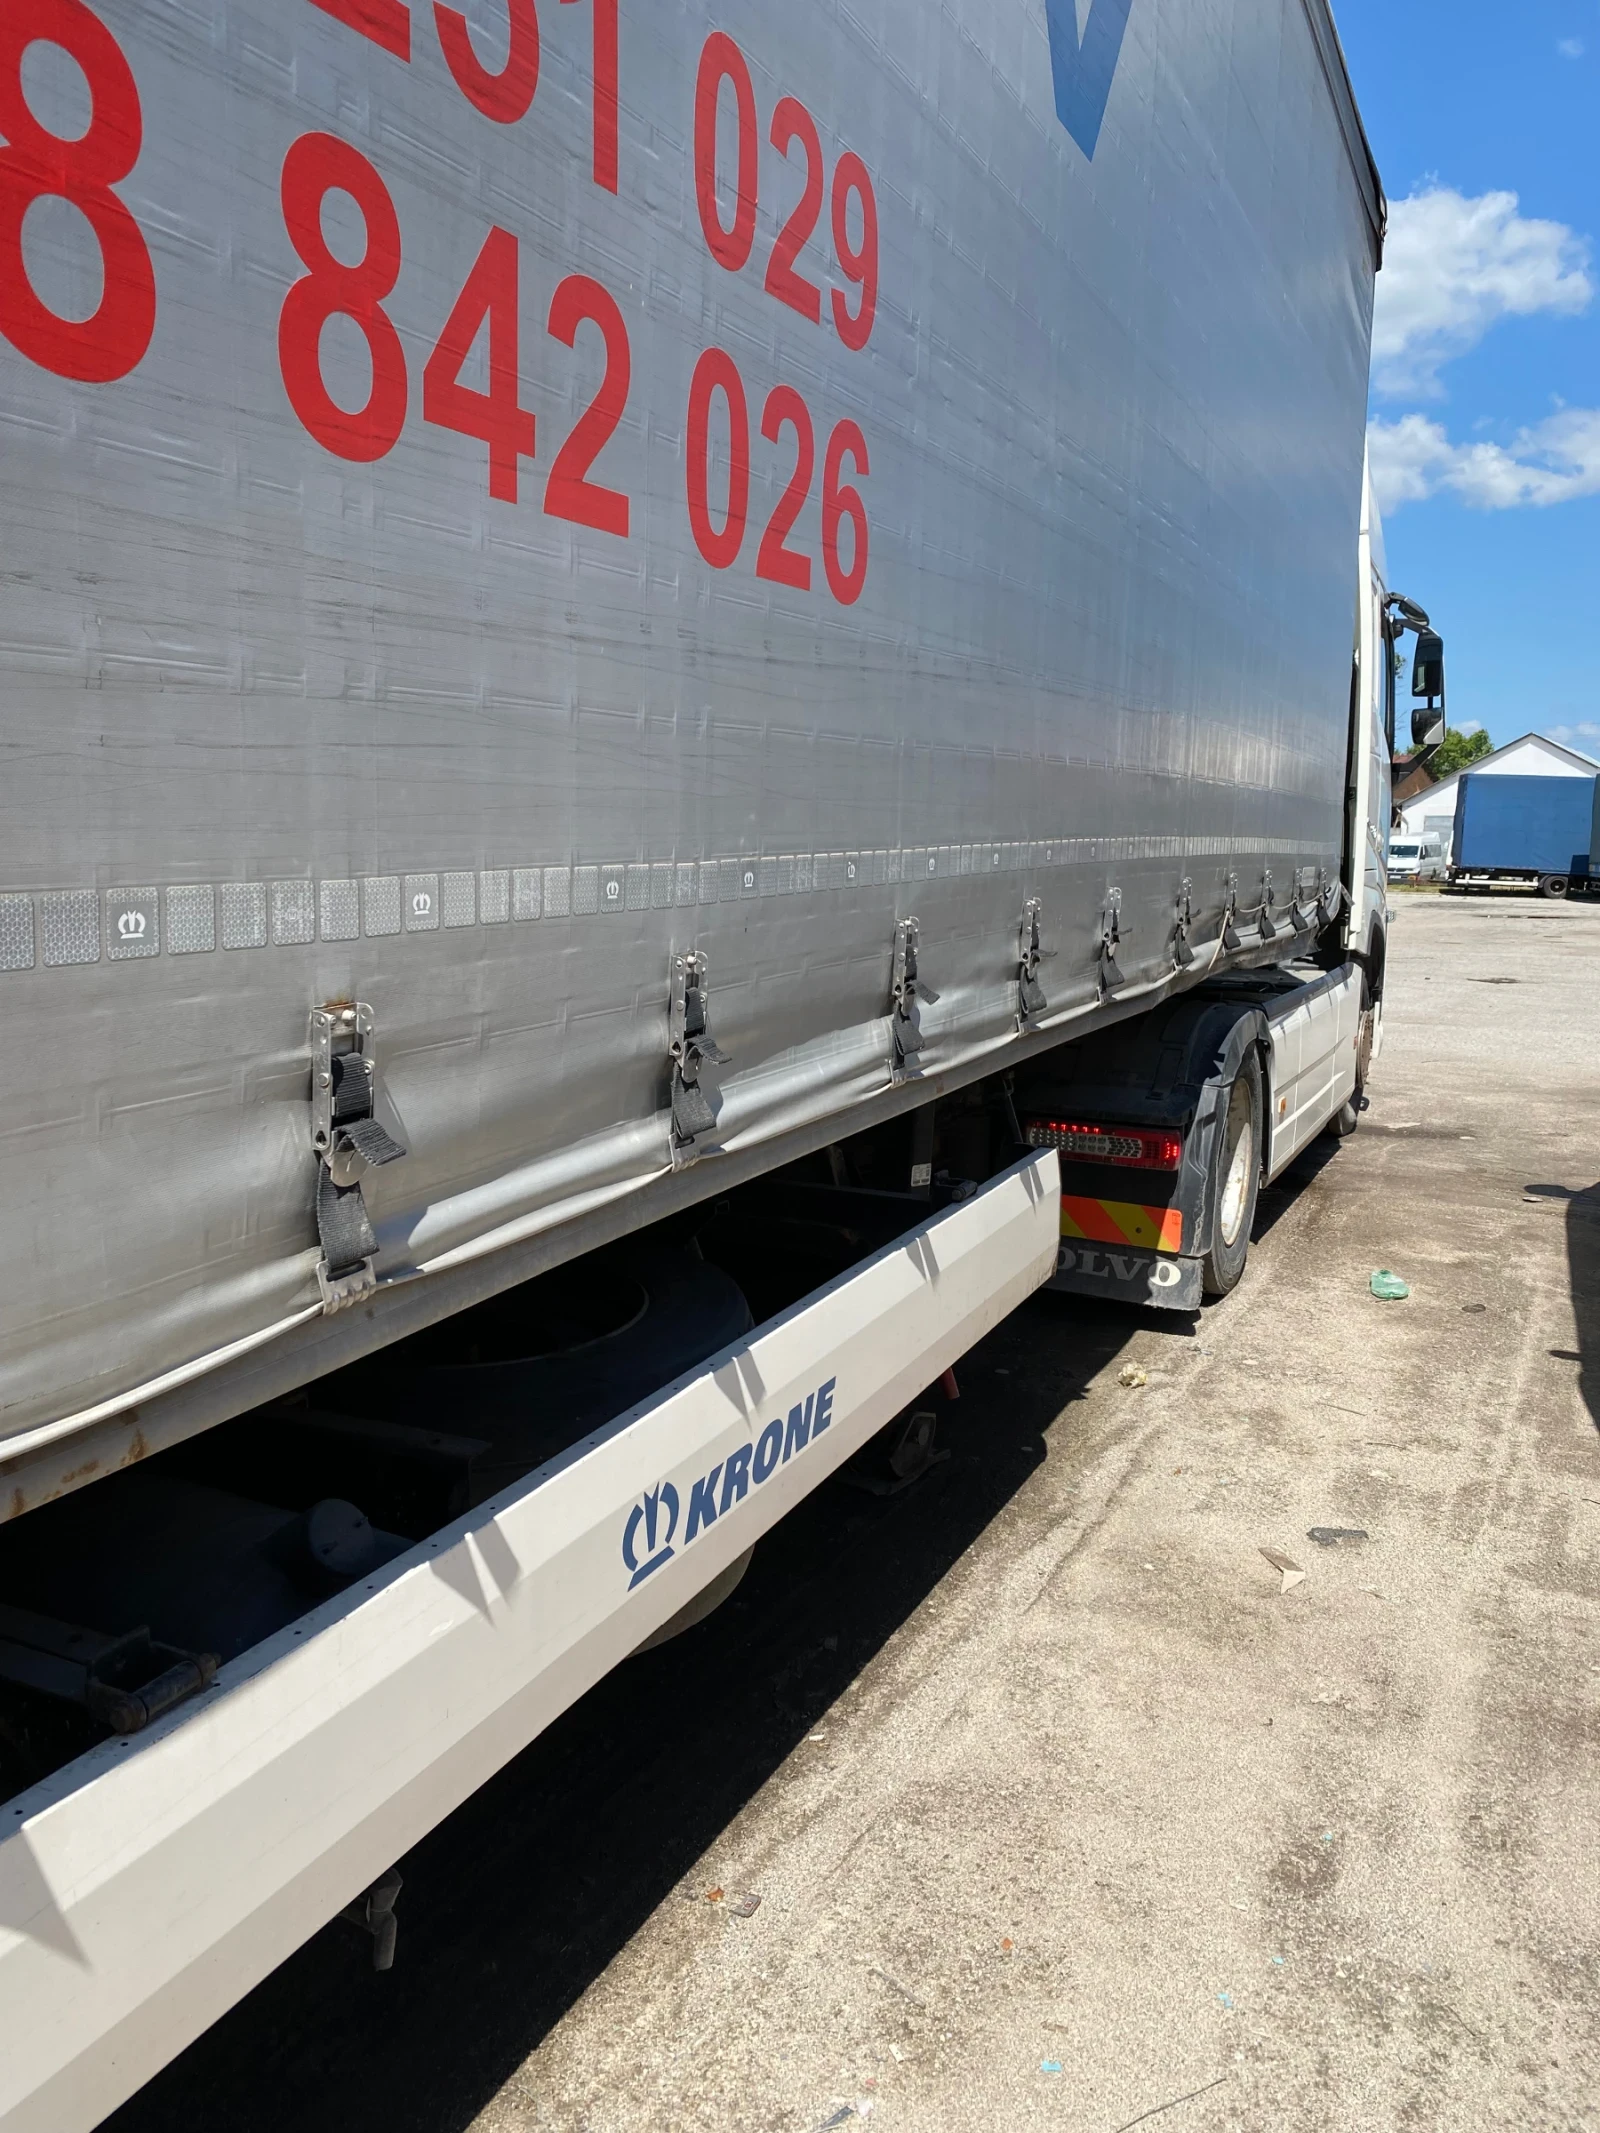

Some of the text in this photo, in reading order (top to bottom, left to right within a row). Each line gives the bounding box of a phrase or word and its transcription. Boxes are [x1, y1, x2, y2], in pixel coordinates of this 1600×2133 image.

[694, 31, 879, 351] 029
[279, 131, 631, 538] 842
[686, 347, 870, 605] 026
[1058, 1245, 1181, 1287] OLVO
[684, 1376, 836, 1546] KRONE
